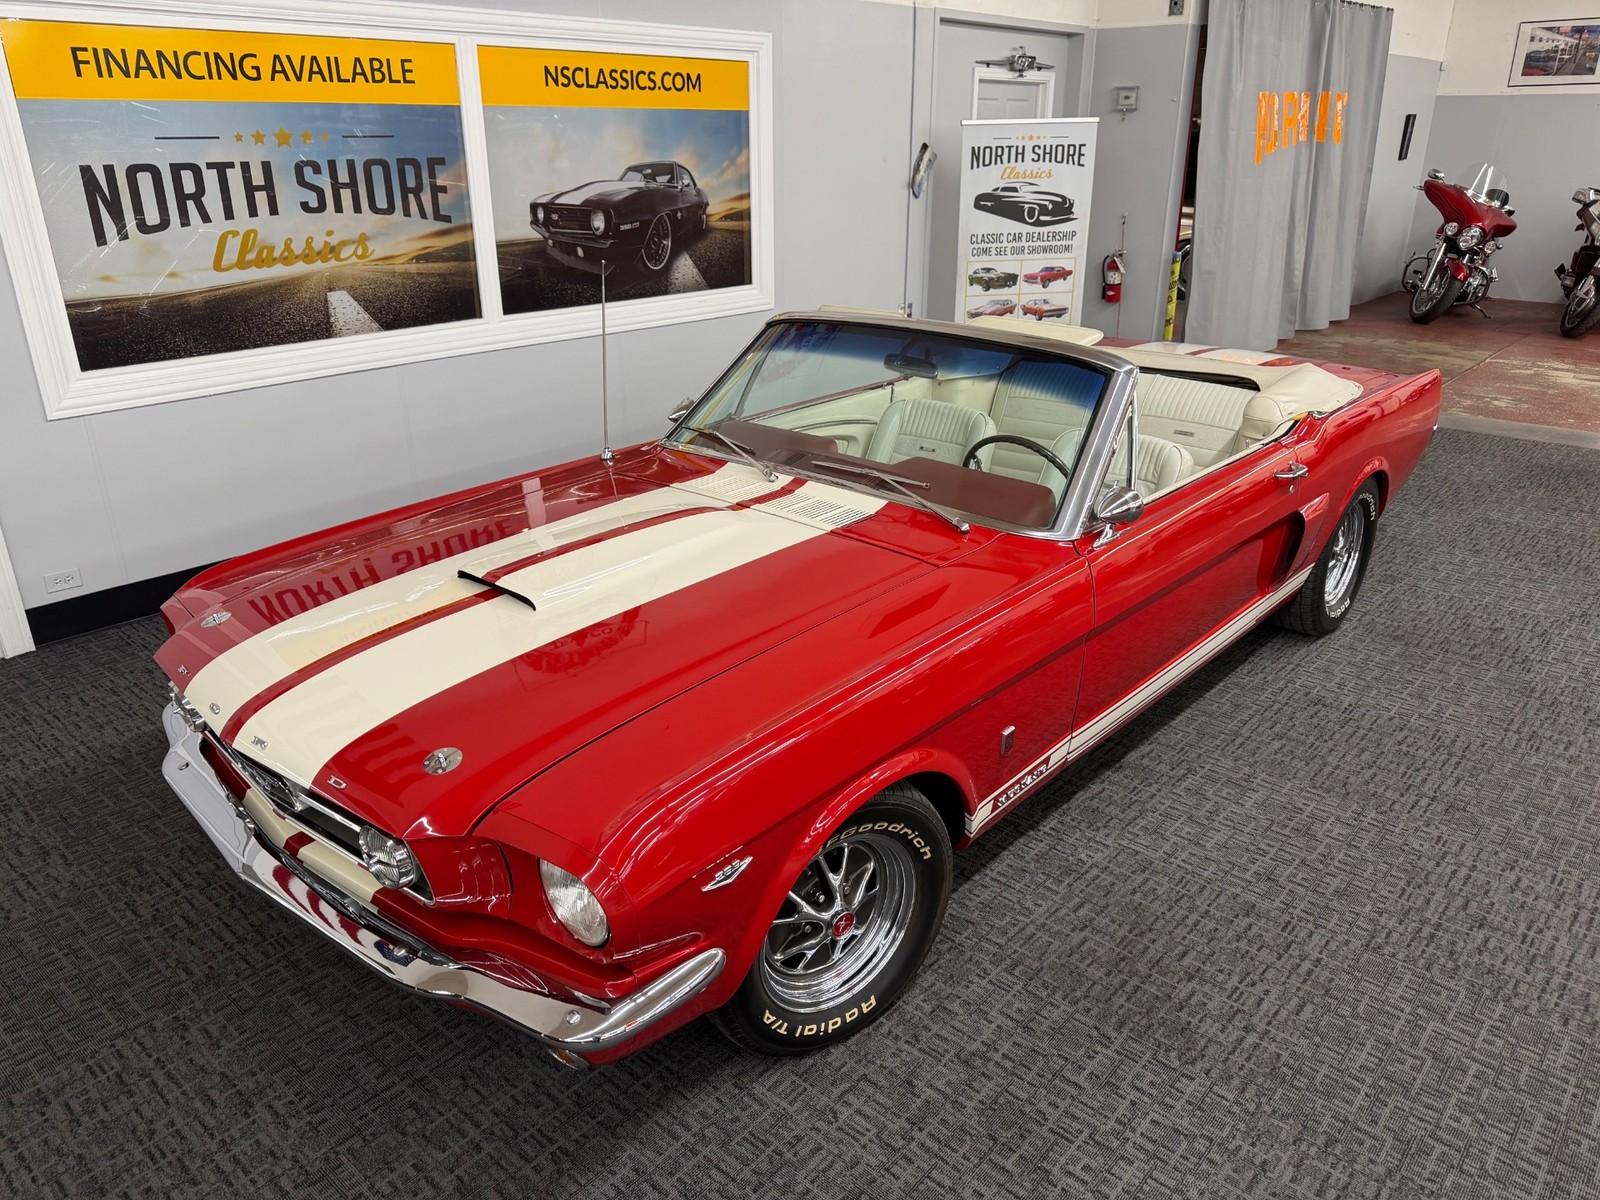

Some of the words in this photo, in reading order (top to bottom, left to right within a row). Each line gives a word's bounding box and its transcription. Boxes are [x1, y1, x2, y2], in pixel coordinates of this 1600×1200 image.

[70, 46, 262, 82] FINANCING
[270, 54, 416, 85] AVAILABLE
[543, 65, 702, 93] NSCLASSICS.COM
[970, 144, 1025, 171] NORTH
[1031, 143, 1086, 168] SHORE
[1000, 166, 1054, 180] Classics
[79, 159, 281, 248] NORTH
[293, 156, 453, 225] SHORE
[212, 228, 376, 273] Classics
[970, 232, 1004, 245] CLASSIC
[1006, 231, 1023, 244] CAR
[1025, 230, 1077, 243] DEALERSHIP
[971, 246, 993, 257] COME
[994, 245, 1009, 256] SEE
[1010, 245, 1026, 256] OUR
[1027, 244, 1073, 255] SHOWROOM!
[763, 1009, 789, 1036] T/A
[795, 995, 877, 1038] Radial
